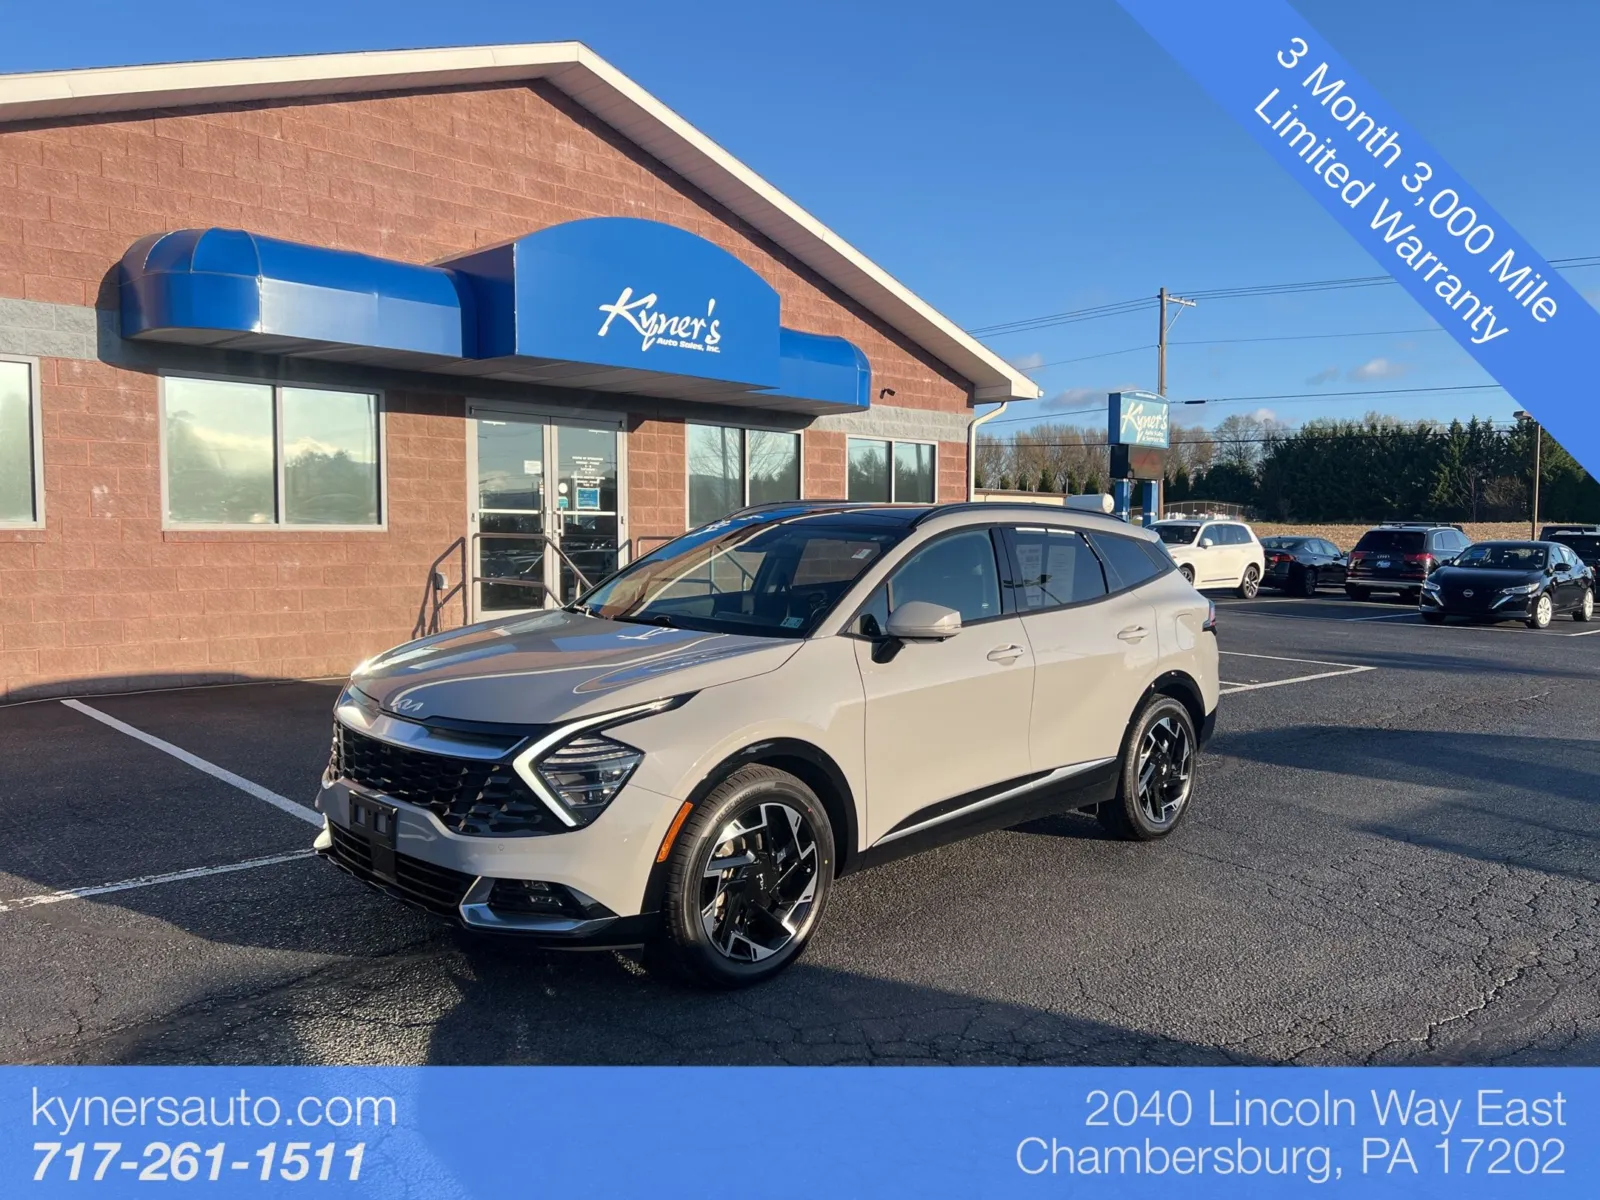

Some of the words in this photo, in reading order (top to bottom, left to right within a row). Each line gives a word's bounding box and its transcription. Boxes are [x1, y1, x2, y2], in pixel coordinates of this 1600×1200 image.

[597, 286, 721, 352] Kyner's
[656, 337, 678, 347] Auto
[679, 341, 705, 352] Sales,
[706, 345, 721, 353] Inc.
[1121, 402, 1168, 444] Kyner's
